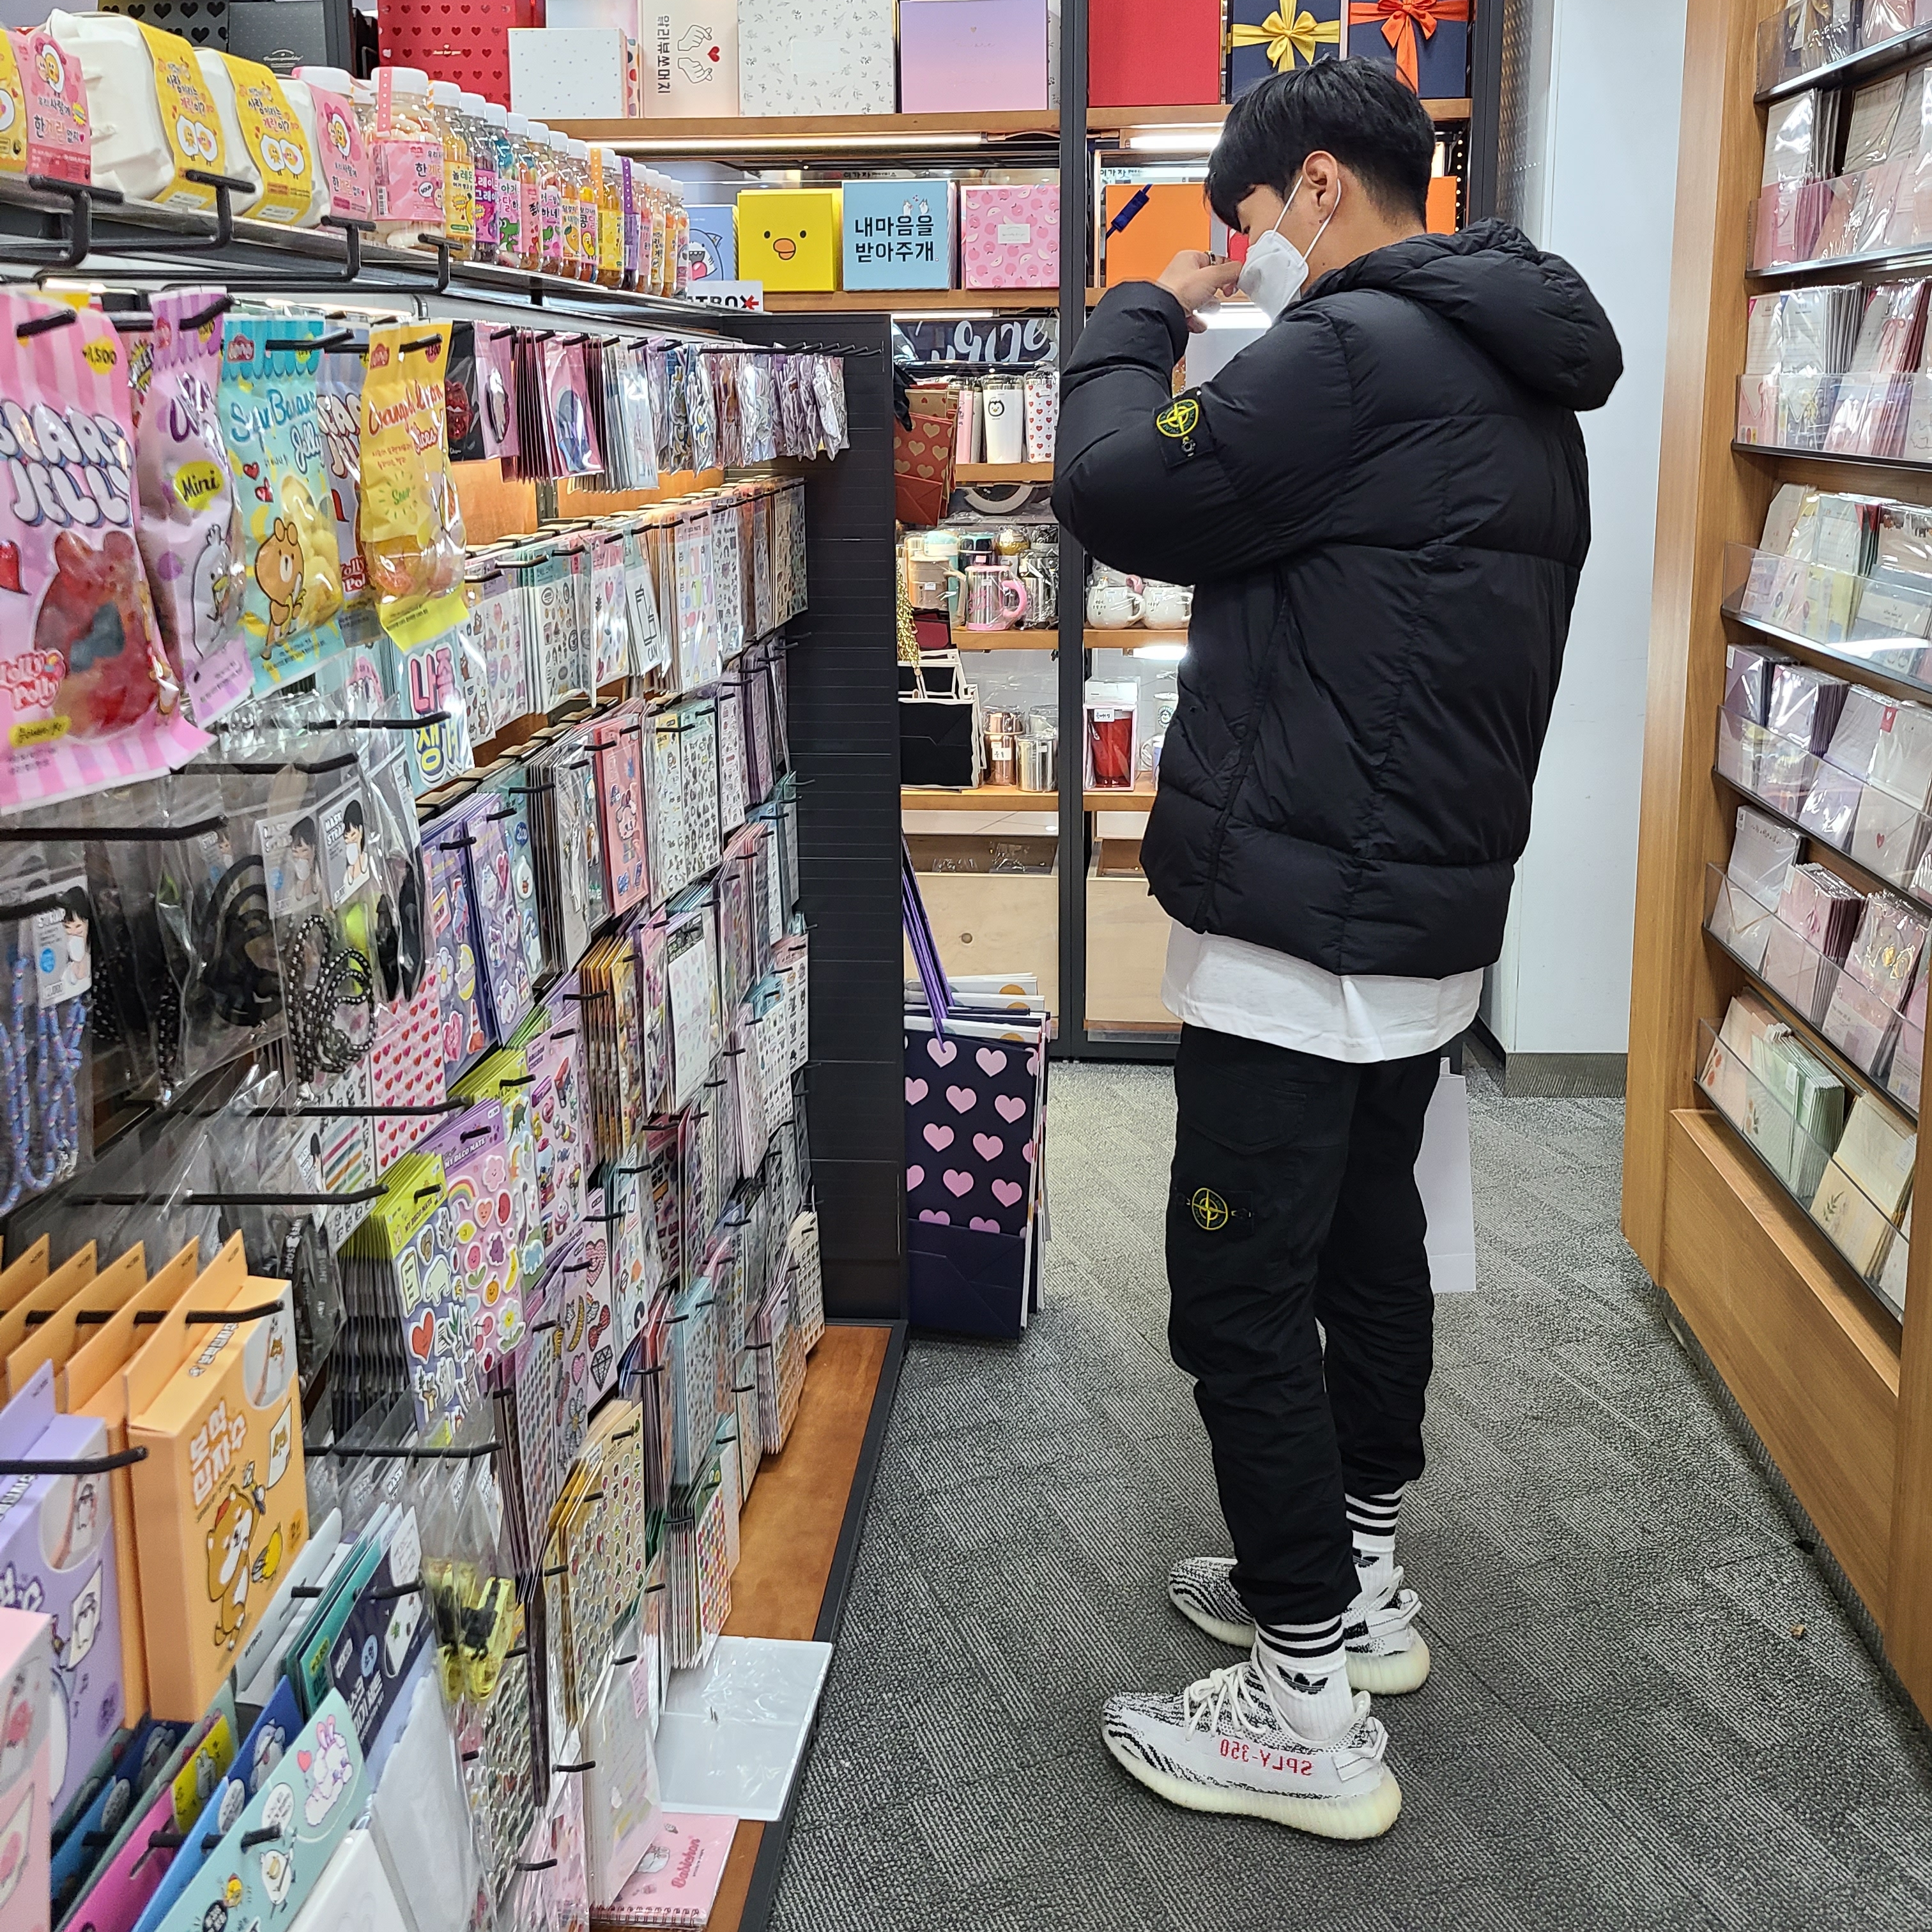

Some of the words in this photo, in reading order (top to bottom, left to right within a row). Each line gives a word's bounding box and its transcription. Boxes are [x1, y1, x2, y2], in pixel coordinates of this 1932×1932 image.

[657, 15, 671, 94] 알라뷰쏘머치
[855, 215, 934, 237] 내마음을
[182, 470, 220, 502] Mini
